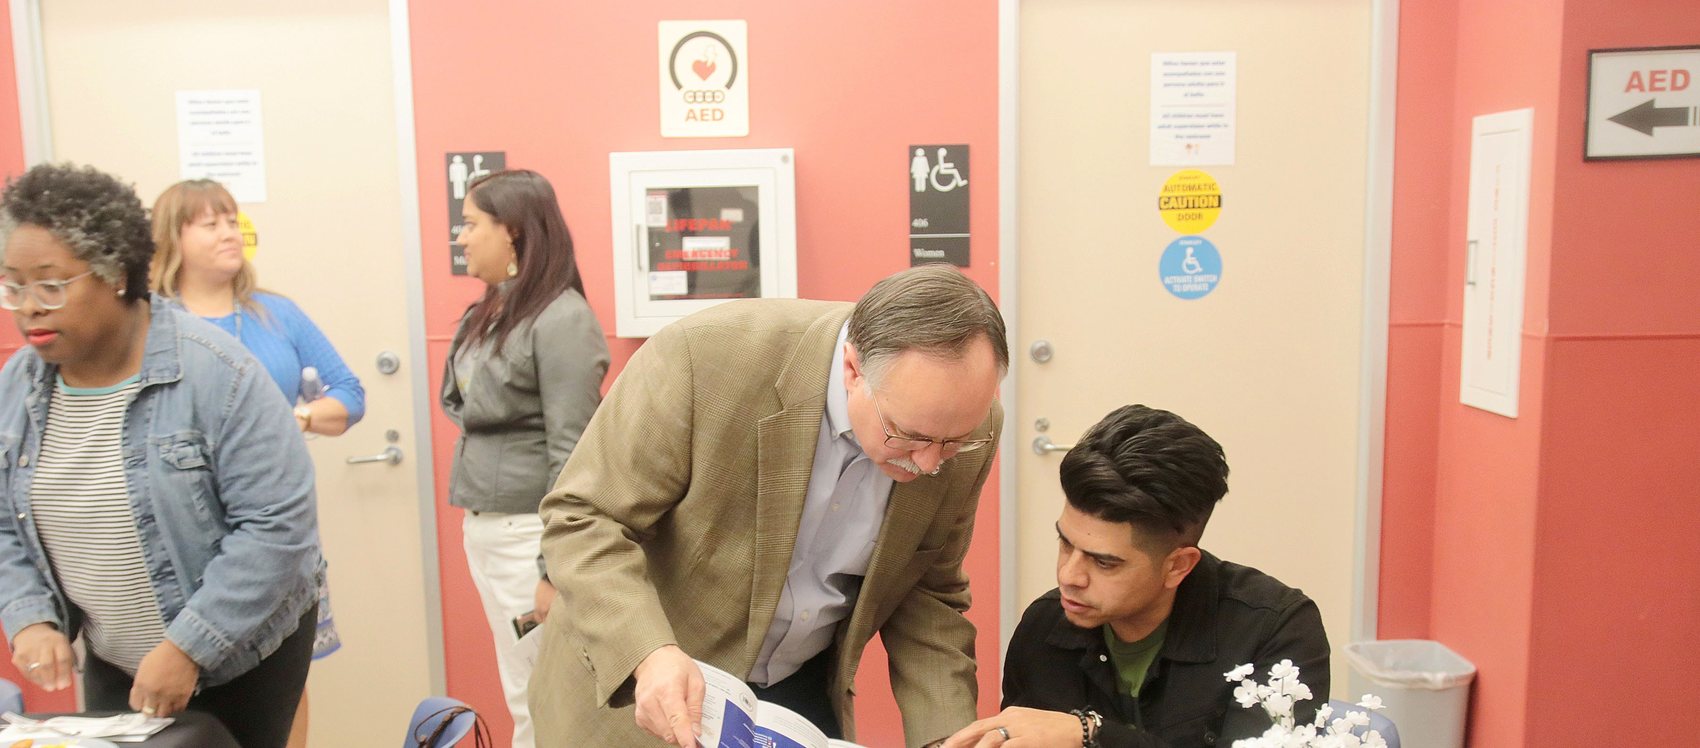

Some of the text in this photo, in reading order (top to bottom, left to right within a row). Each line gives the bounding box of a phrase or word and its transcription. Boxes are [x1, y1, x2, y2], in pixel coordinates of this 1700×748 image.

[1624, 69, 1691, 93] AED
[685, 108, 724, 122] AED
[1159, 196, 1219, 209] CAUTION
[1177, 213, 1203, 221] DOOR
[913, 248, 945, 258] Women
